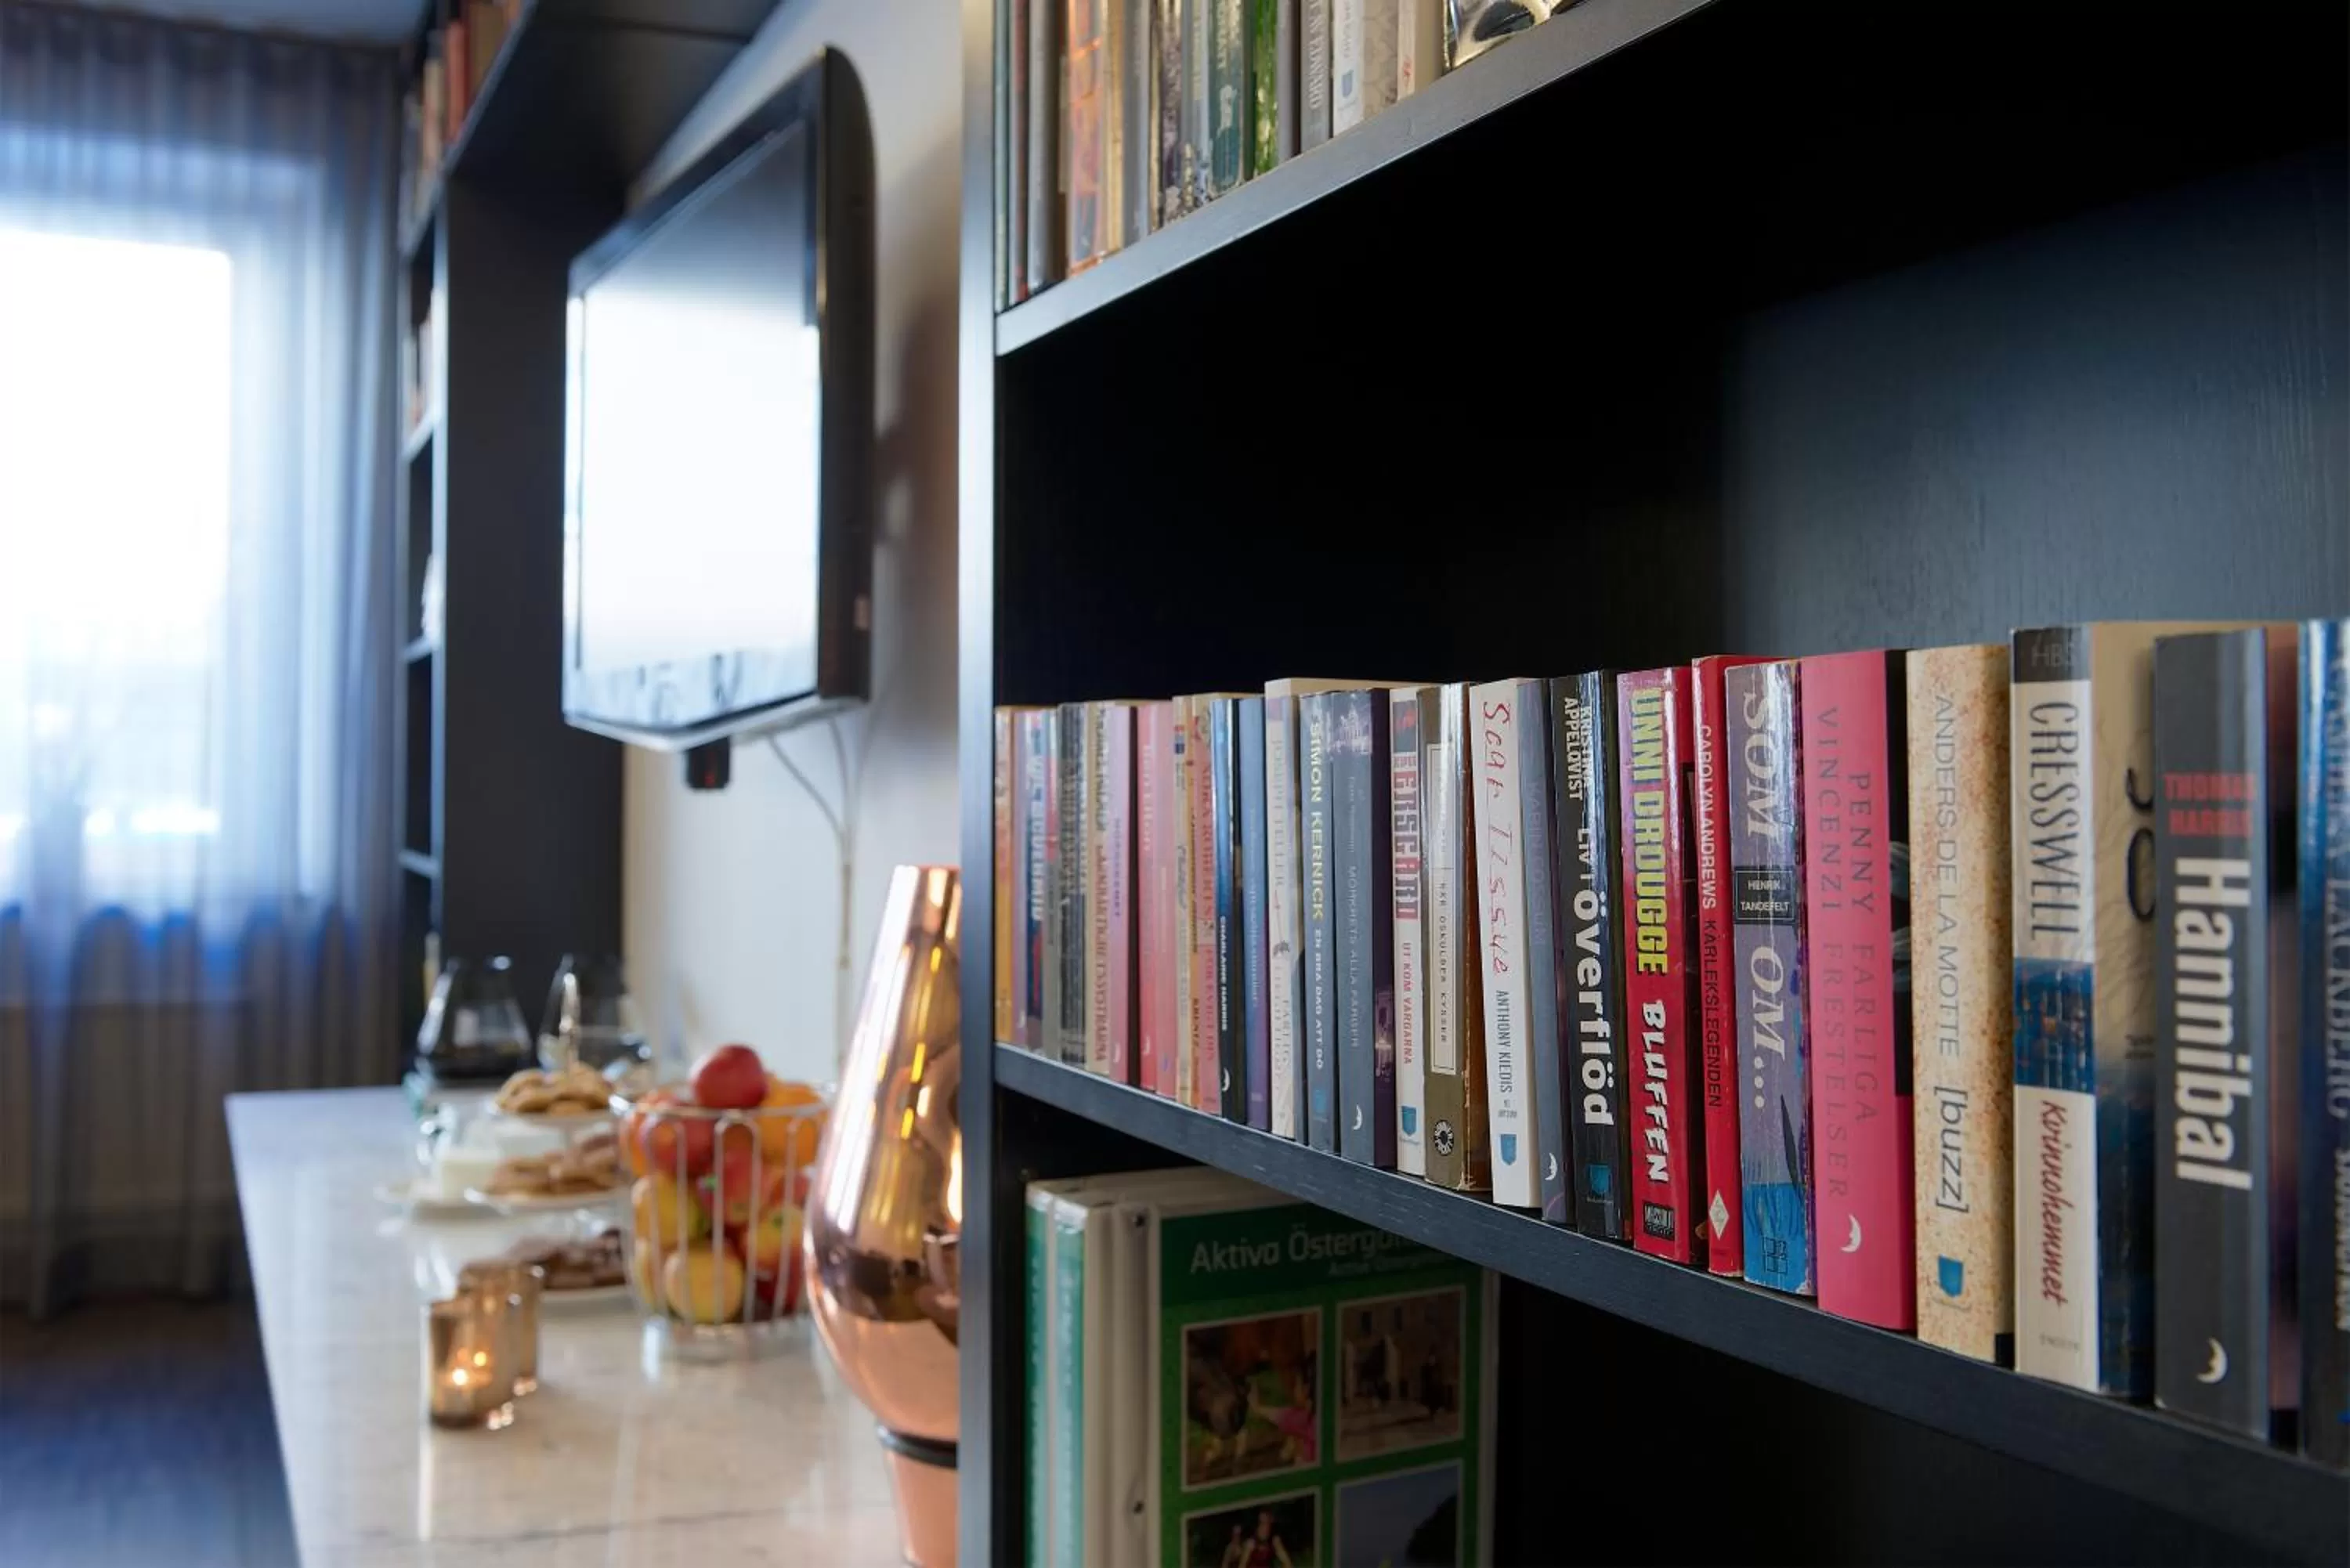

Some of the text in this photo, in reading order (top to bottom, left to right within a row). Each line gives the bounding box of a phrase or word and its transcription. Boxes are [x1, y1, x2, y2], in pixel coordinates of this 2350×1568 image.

[1310, 721, 1323, 802] SIMON
[1482, 700, 1512, 800] Scar
[1564, 697, 1583, 800] APPELQVIST
[1579, 706, 1593, 788] KRISTINA
[1630, 688, 1665, 782] UNNI
[1742, 692, 1781, 844] SOM
[1310, 811, 1324, 921] KERNICK
[1632, 790, 1668, 974] DROUGGE
[1747, 880, 1781, 891] HENRIK
[2029, 700, 2082, 942] CRESSWELL
[1488, 822, 1513, 974] Tissue
[1700, 724, 1722, 1107] CAROLYN ANDREWS KÄRLEKSLEGENDEN
[1817, 707, 1849, 1198] VINCENZI FRESTELSER
[1848, 771, 1879, 1122] PENNY FARLIGA
[1932, 695, 1970, 1215] ANDERS DE LA MOTTE [buzz]
[1403, 962, 1412, 992] KOM
[1404, 996, 1413, 1065] VARGARNA
[1495, 989, 1512, 1048] ANTHONY
[1573, 889, 1614, 1126] överflöd
[2174, 856, 2254, 1191] Hannibal
[1498, 1052, 1513, 1093] KIEDIS
[1642, 999, 1669, 1182] BLUFFEN
[1189, 1237, 1281, 1275] Aktiva
[2038, 1098, 2076, 1308] Kvinnohemmet
